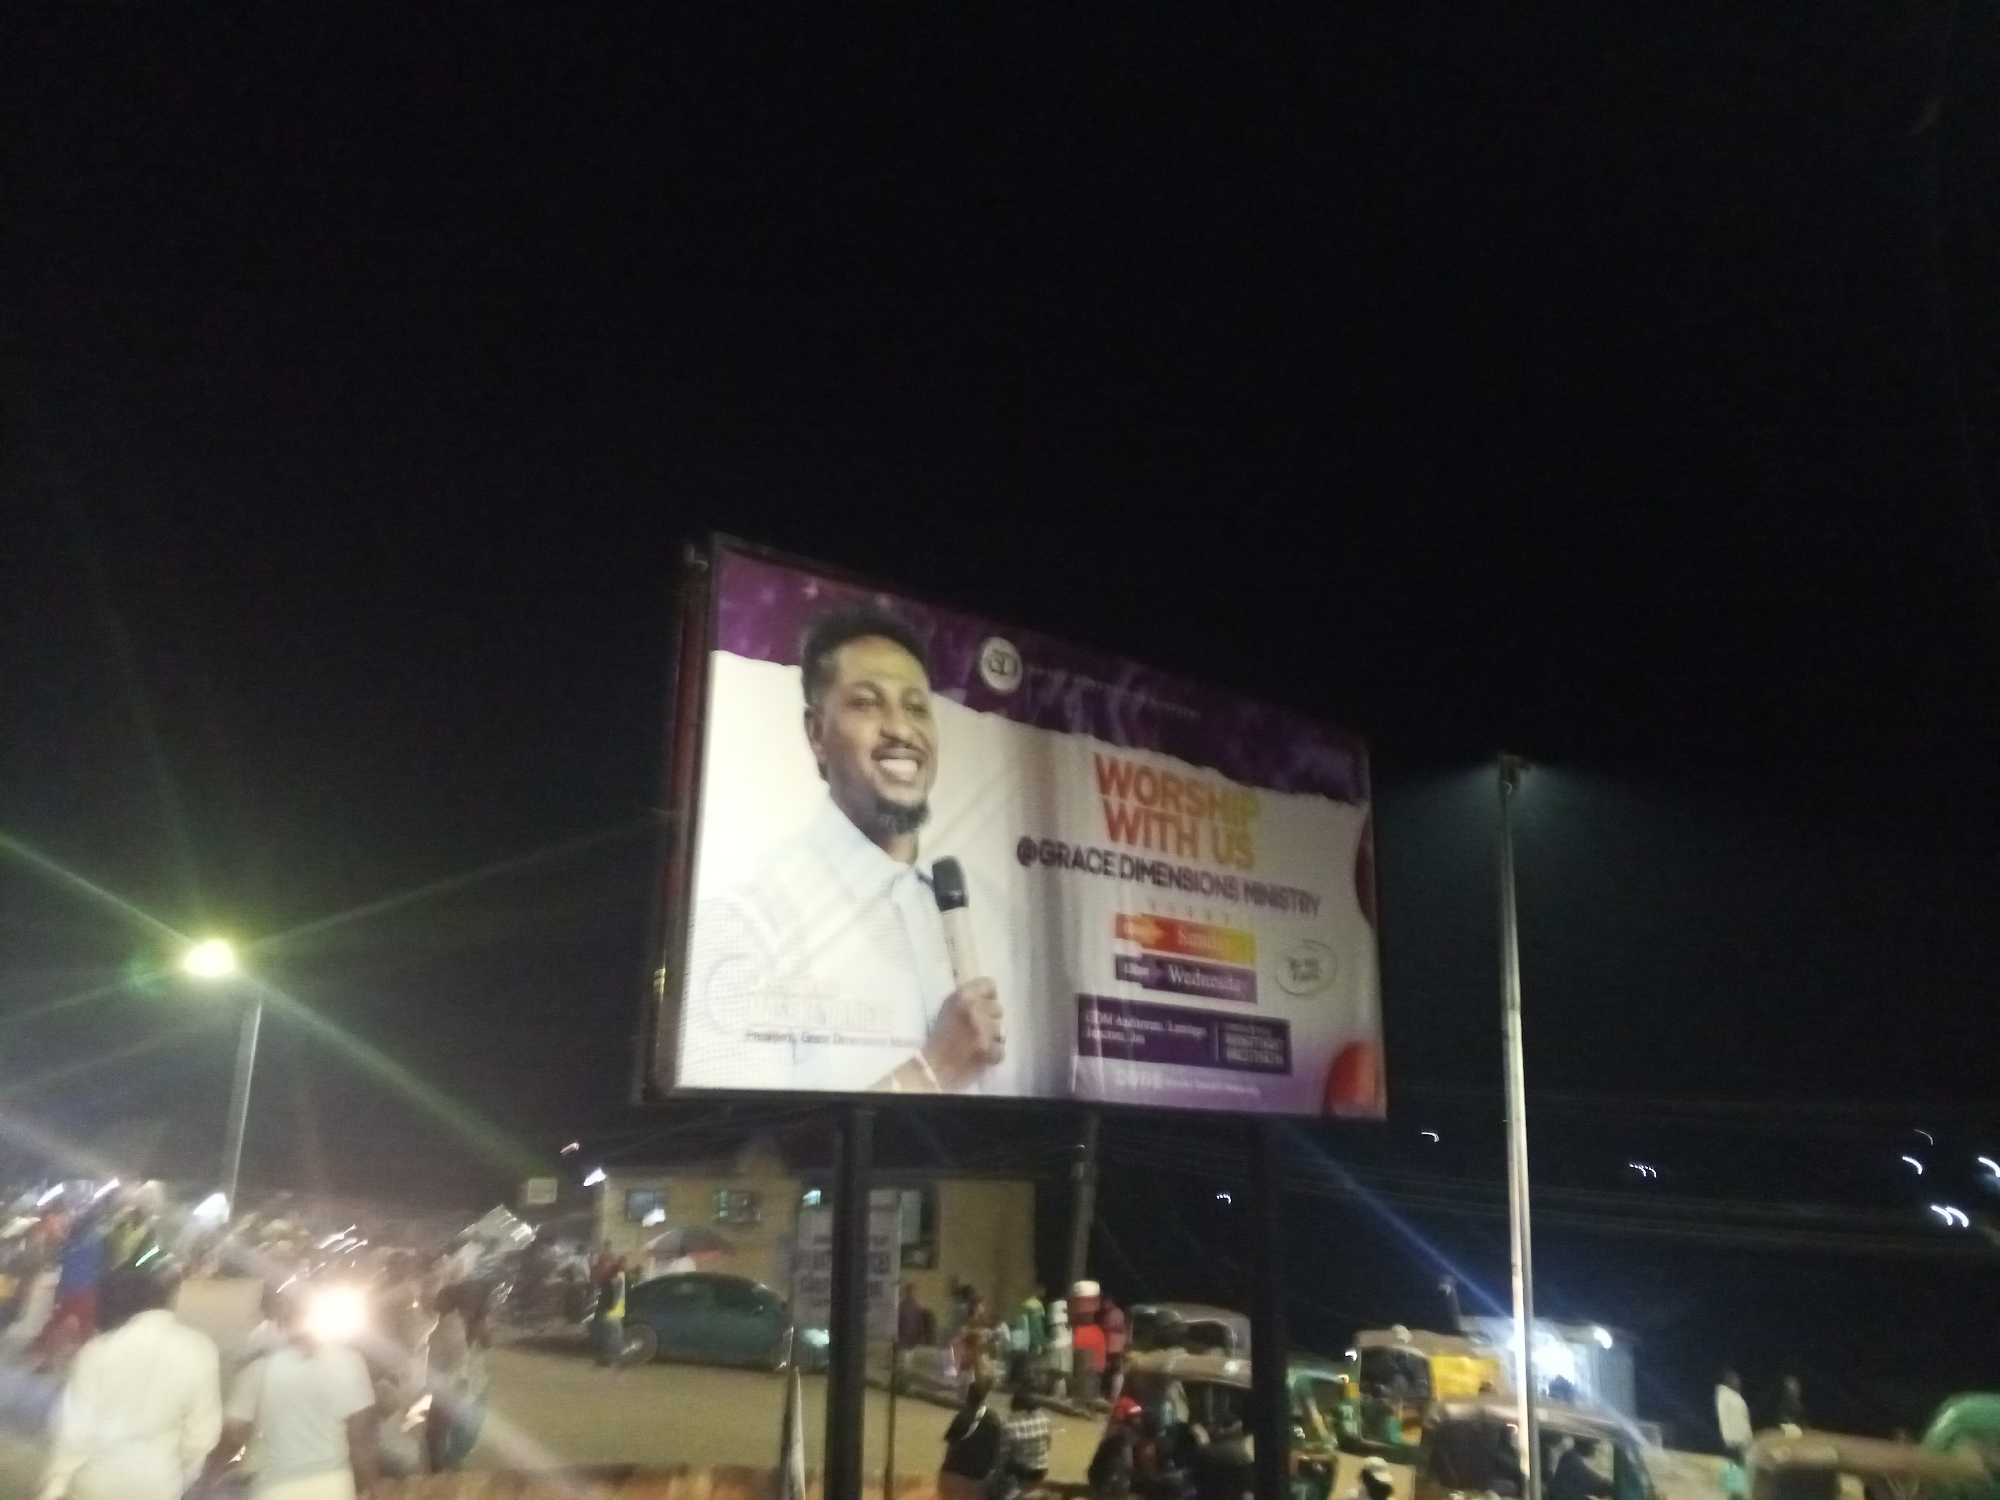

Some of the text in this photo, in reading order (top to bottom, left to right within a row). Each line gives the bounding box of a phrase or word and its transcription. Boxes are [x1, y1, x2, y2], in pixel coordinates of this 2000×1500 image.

[1095, 752, 1258, 821] WORSHIP
[1102, 799, 1257, 870] WITH US
[1119, 853, 1241, 902] DIMENSIONS
[1243, 880, 1321, 917] MINISTRY
[1167, 963, 1248, 1000] Wednesday
